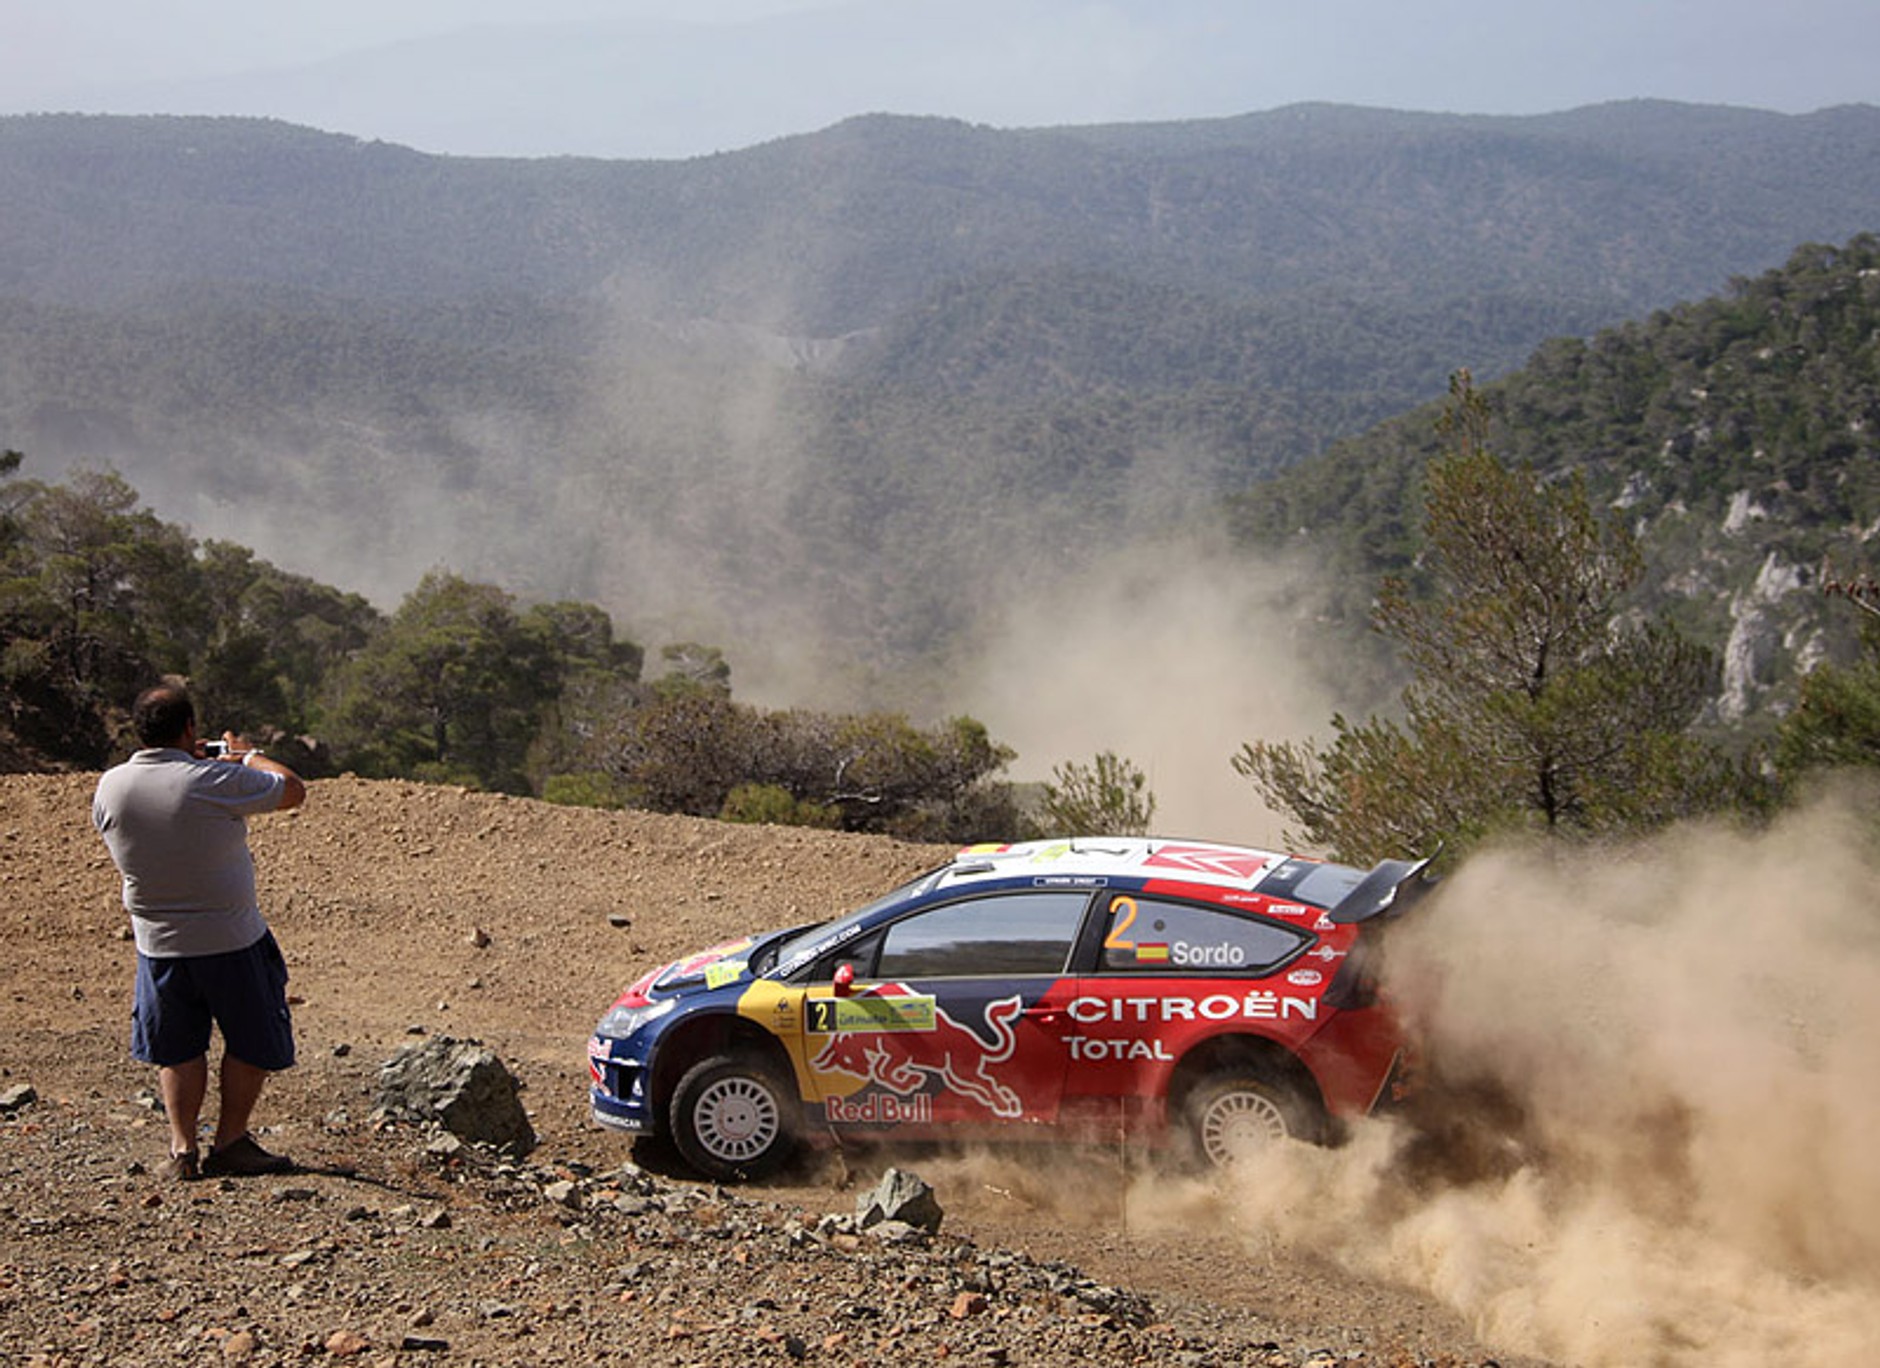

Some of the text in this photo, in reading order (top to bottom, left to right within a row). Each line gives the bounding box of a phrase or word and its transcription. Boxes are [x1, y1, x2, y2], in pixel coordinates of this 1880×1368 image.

[1104, 895, 1138, 949] 2
[1172, 940, 1245, 965] Sordo
[814, 1002, 828, 1031] 2
[1066, 990, 1317, 1022] CITROËN
[825, 1092, 932, 1122] Red Bull
